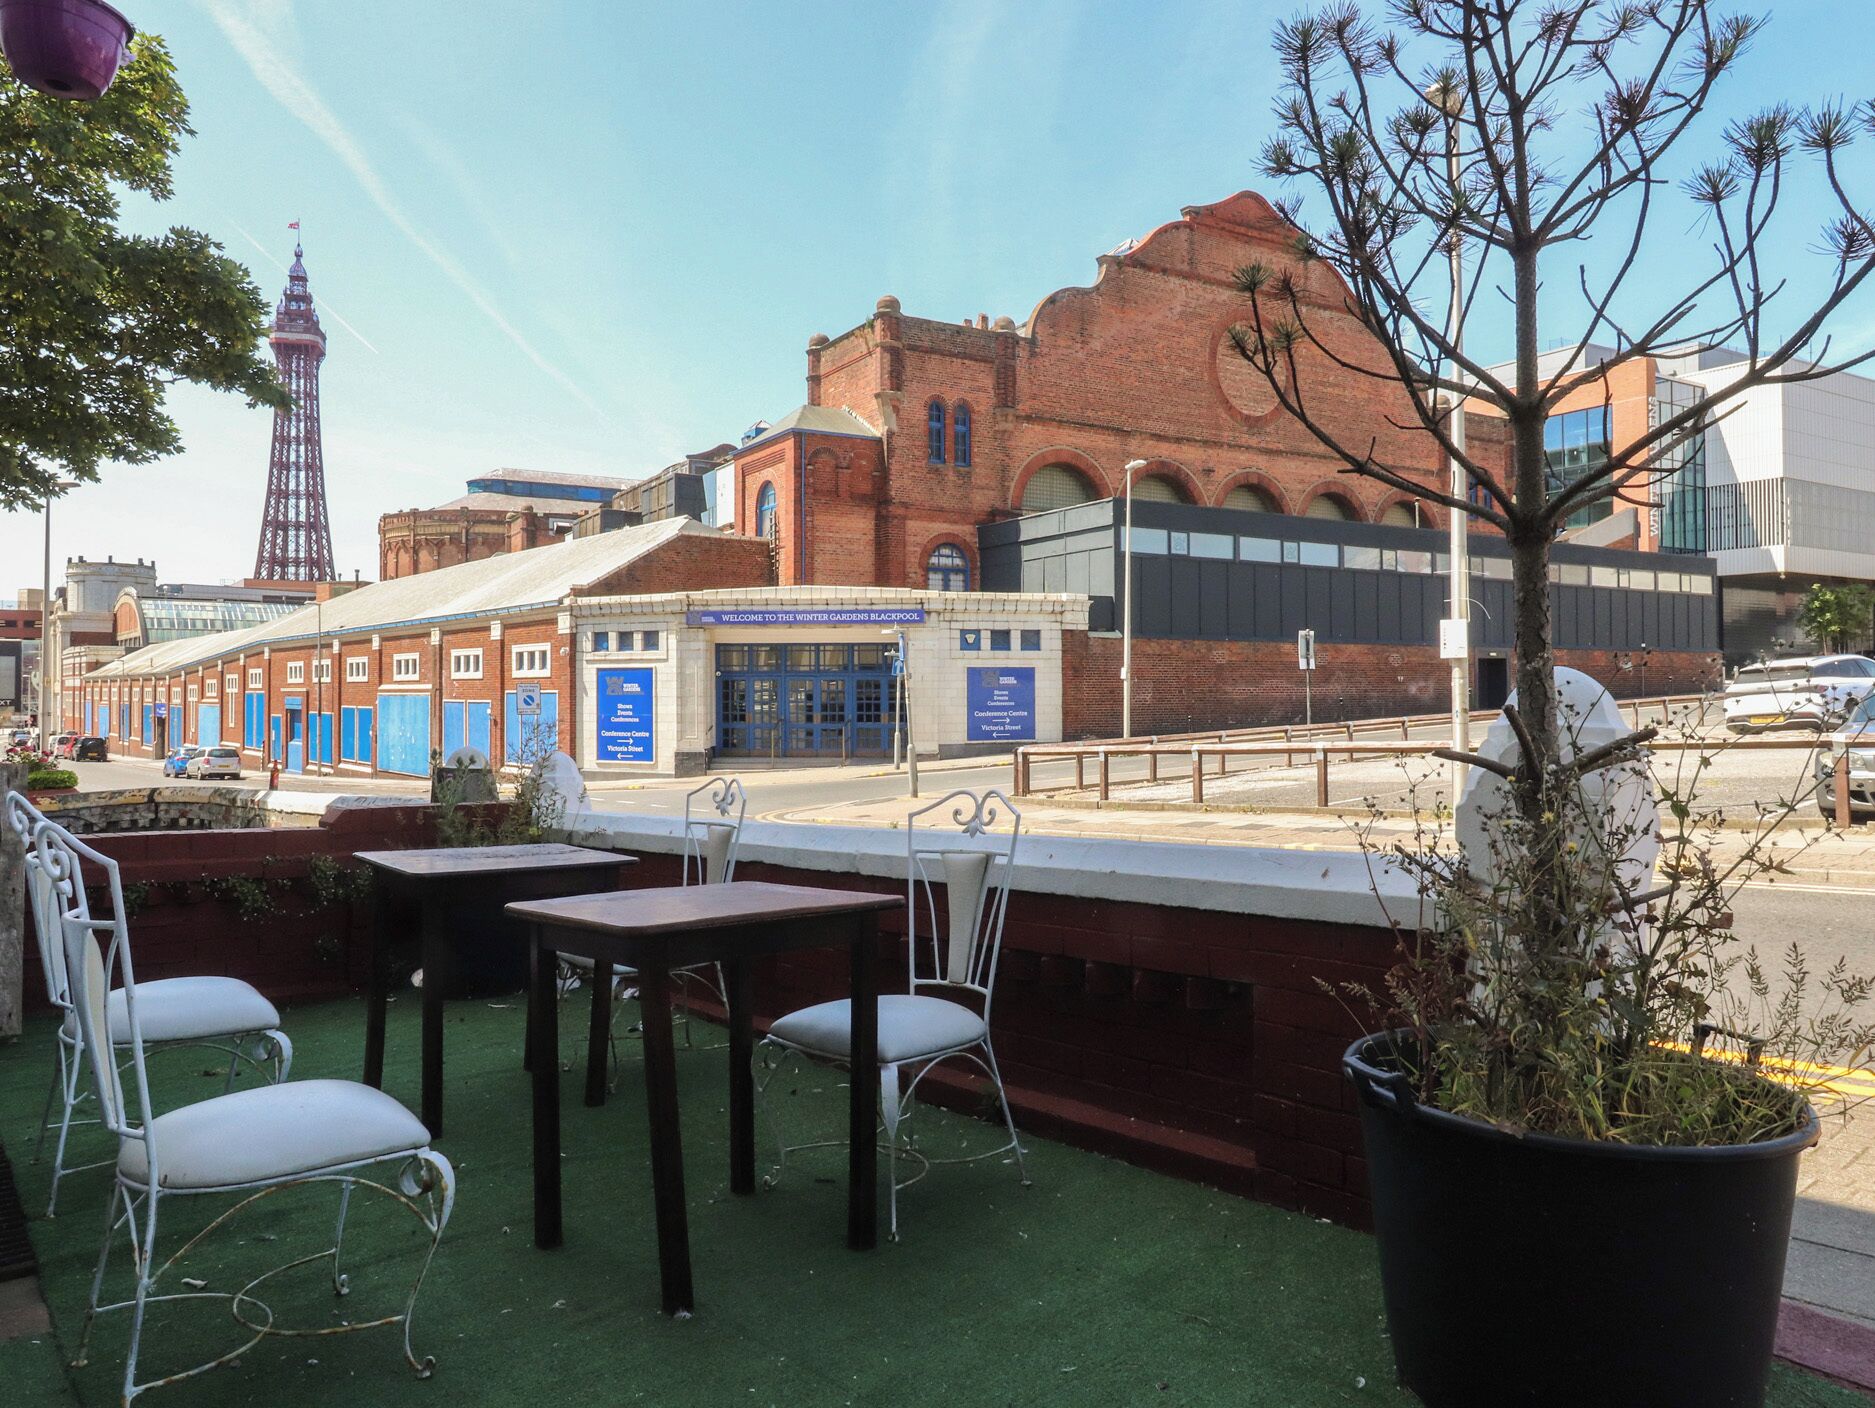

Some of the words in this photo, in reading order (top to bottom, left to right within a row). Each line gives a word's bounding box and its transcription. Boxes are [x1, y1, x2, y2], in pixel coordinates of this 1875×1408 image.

[721, 614, 763, 622] WELCOME
[764, 614, 776, 622] TO
[796, 613, 829, 621] WINTER
[829, 613, 869, 621] GARDENS
[870, 612, 920, 620] BLACKPOOL
